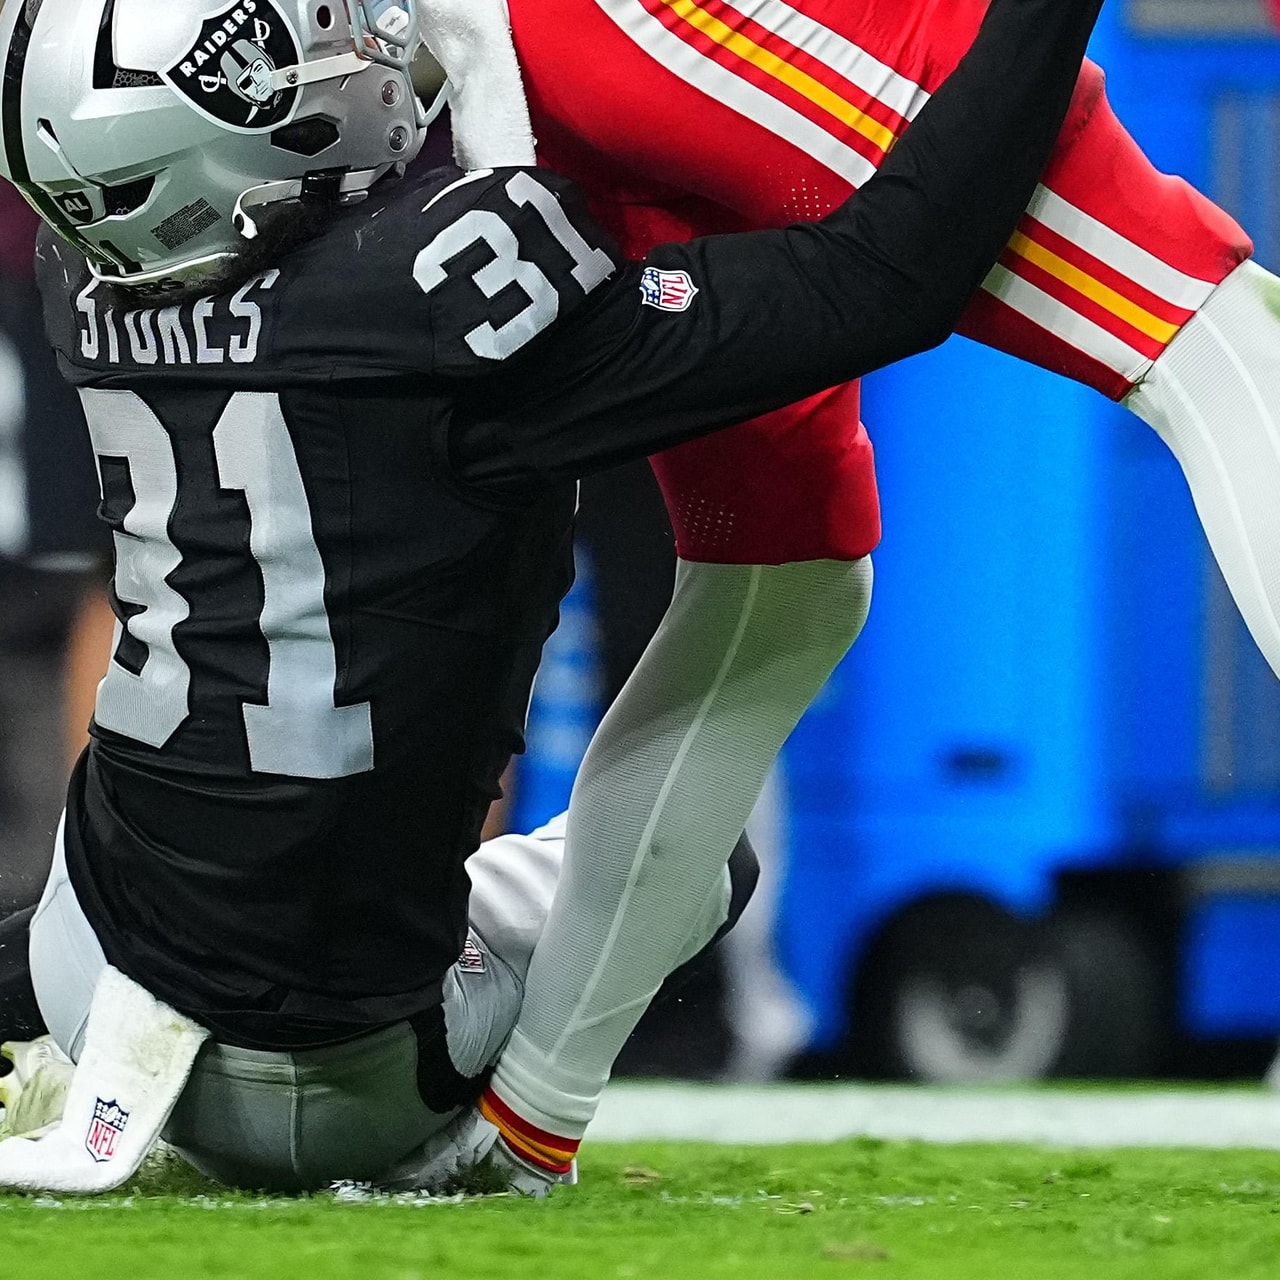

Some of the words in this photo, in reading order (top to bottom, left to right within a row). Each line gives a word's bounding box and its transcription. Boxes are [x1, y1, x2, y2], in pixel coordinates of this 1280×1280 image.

[62, 197, 90, 213] AL
[412, 170, 616, 361] 31
[661, 276, 688, 307] NFL
[78, 387, 375, 779] 31
[89, 1120, 116, 1156] NFL
